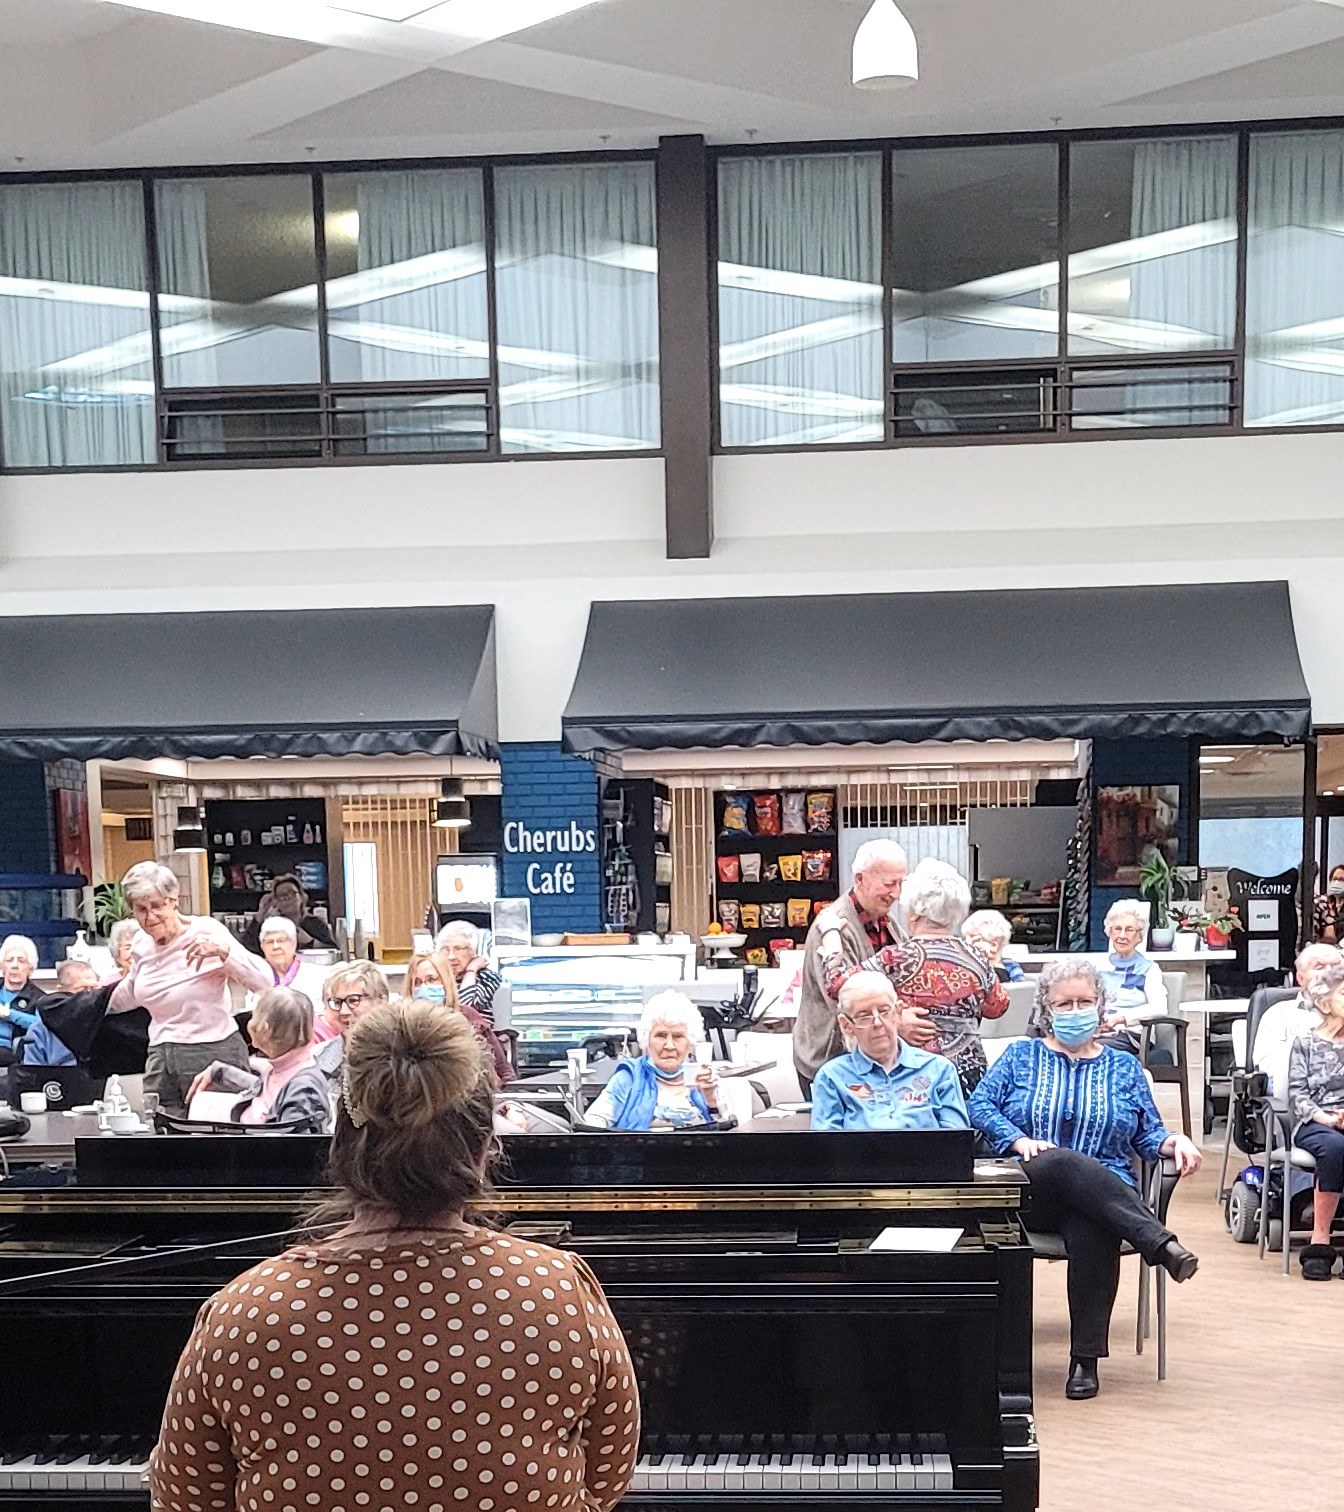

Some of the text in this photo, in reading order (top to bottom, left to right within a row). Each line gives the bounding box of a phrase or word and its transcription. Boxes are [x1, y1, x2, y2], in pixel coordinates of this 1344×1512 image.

[503, 821, 595, 853] Cherubs
[526, 862, 575, 894] Café
[1236, 878, 1292, 895] Welcome
